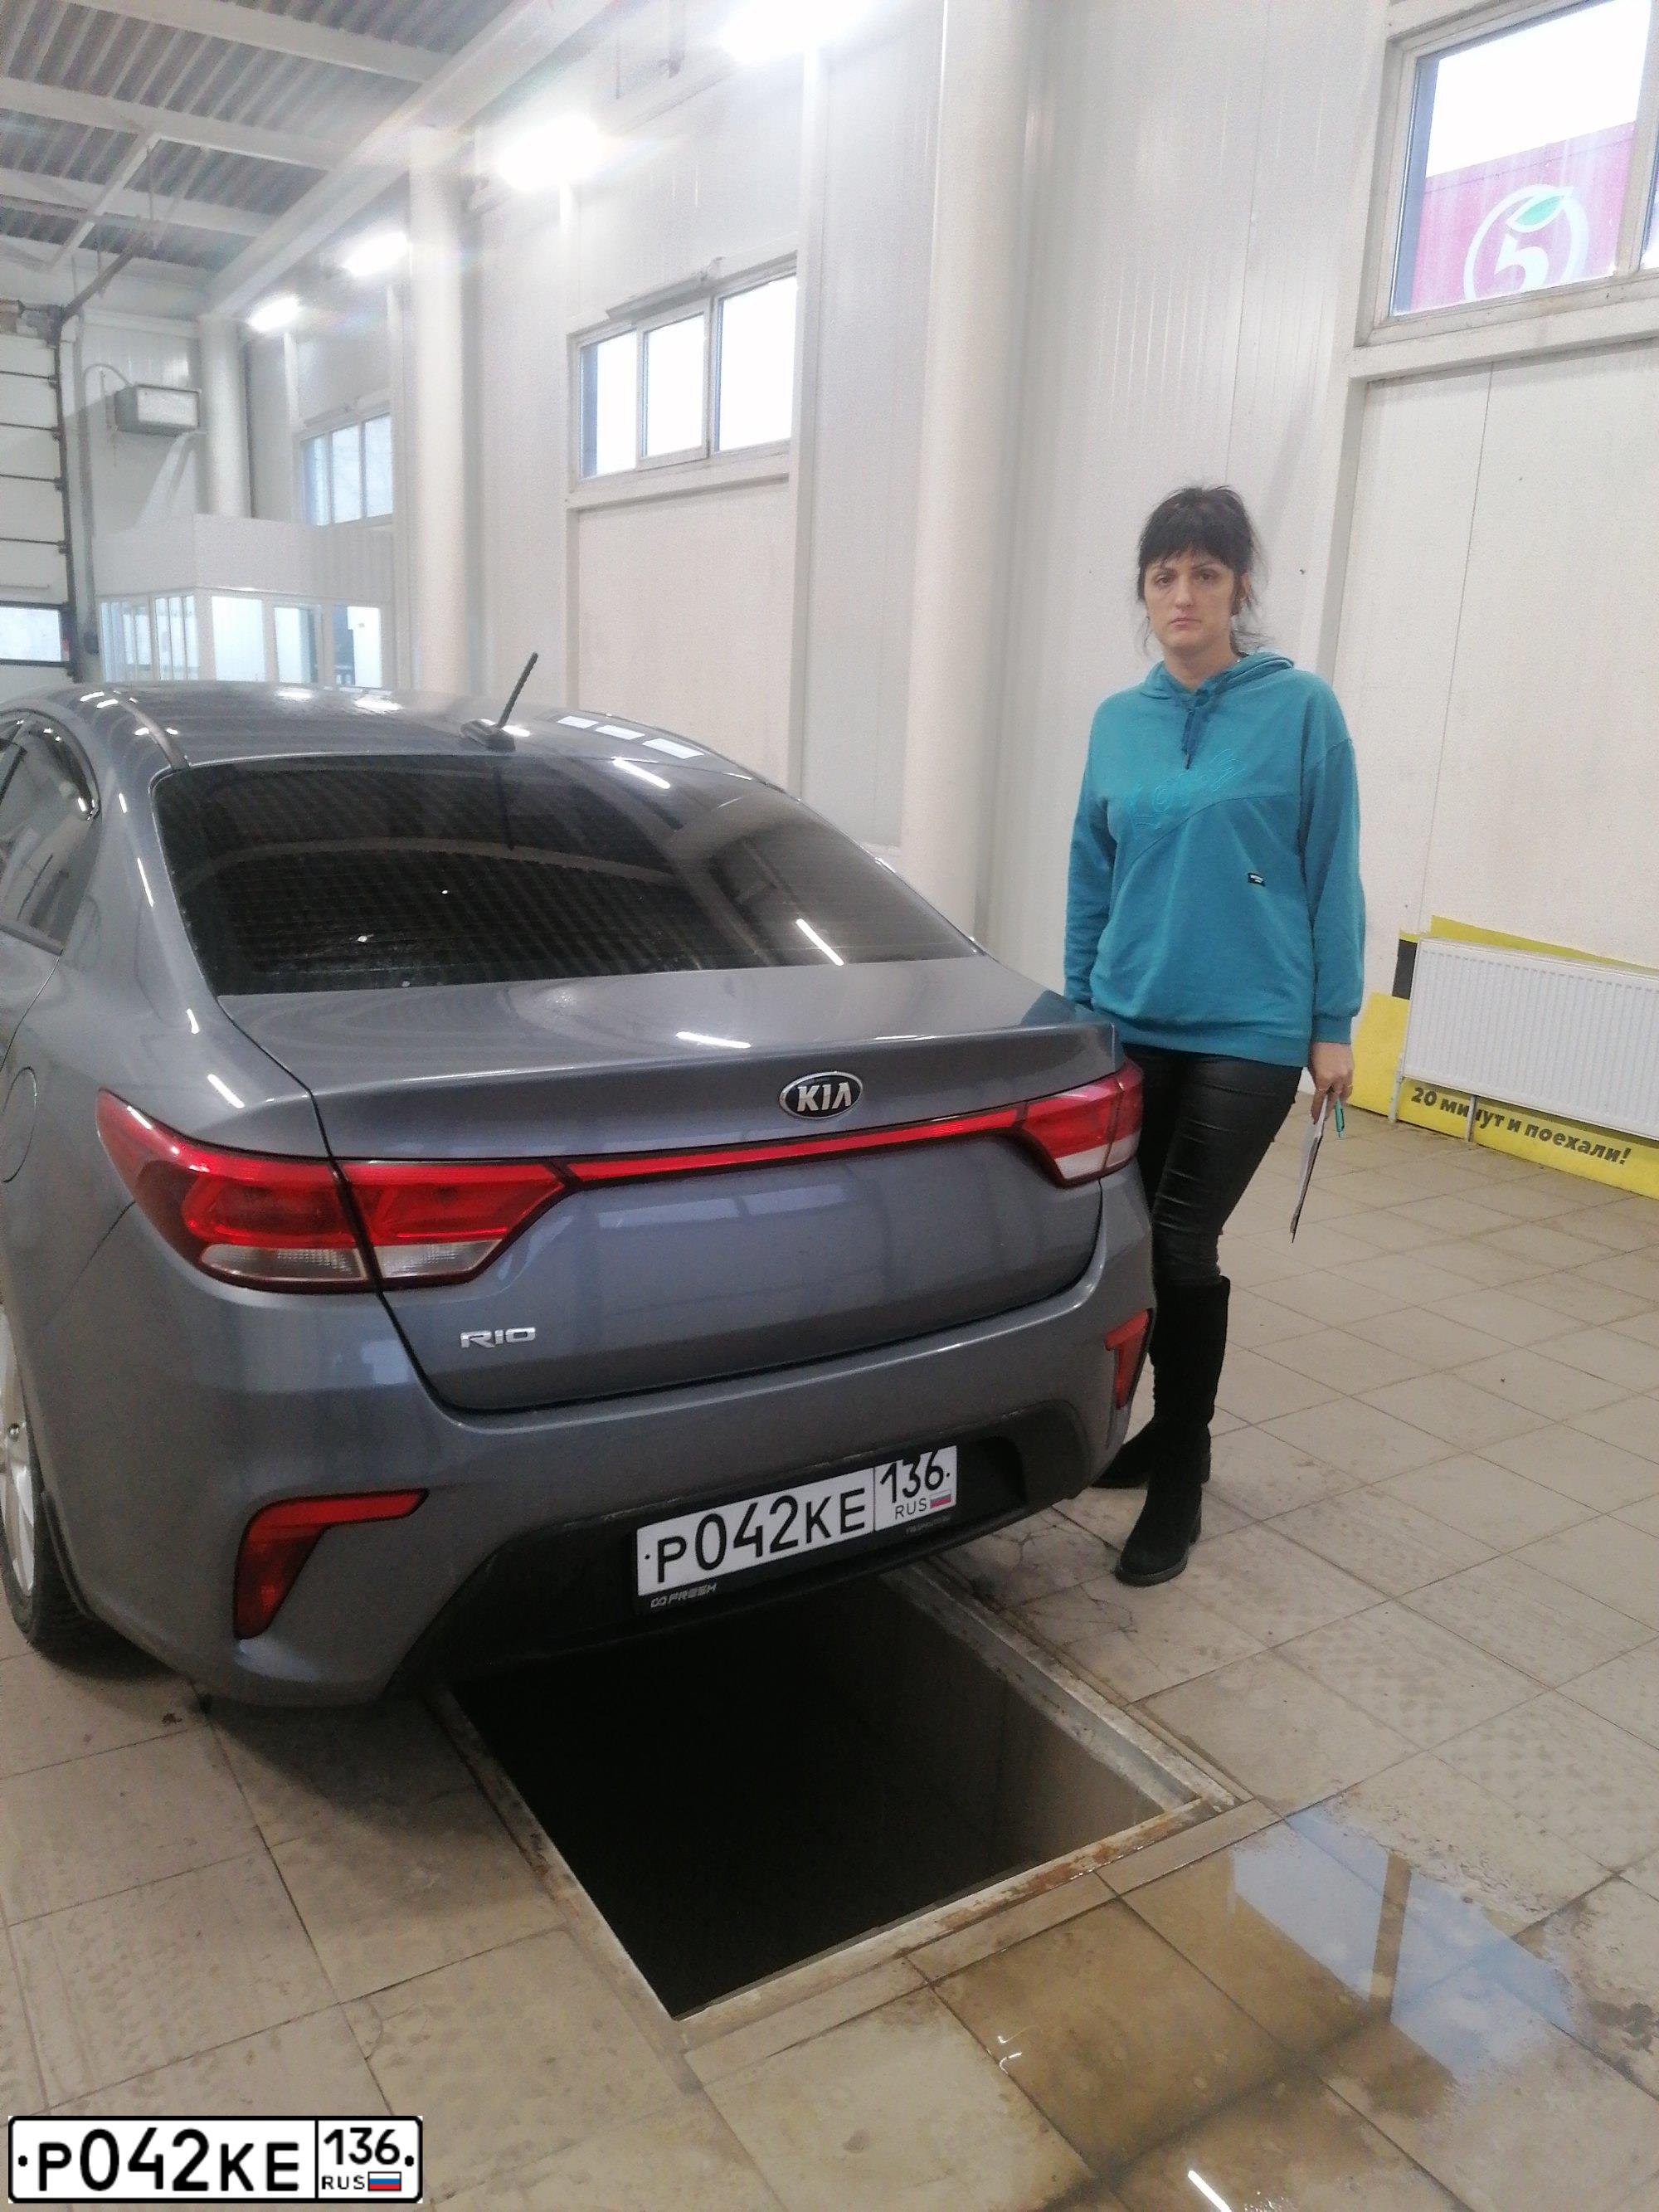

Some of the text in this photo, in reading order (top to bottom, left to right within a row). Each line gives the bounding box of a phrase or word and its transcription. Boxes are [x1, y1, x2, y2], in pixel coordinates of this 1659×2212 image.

[796, 1082, 852, 1112] KIA
[1410, 1087, 1438, 1106] 20
[1506, 1118, 1521, 1133] и
[1525, 1123, 1632, 1165] поехали!
[460, 1327, 536, 1348] RIO
[879, 1449, 944, 1503] 136
[894, 1498, 927, 1520] RUS
